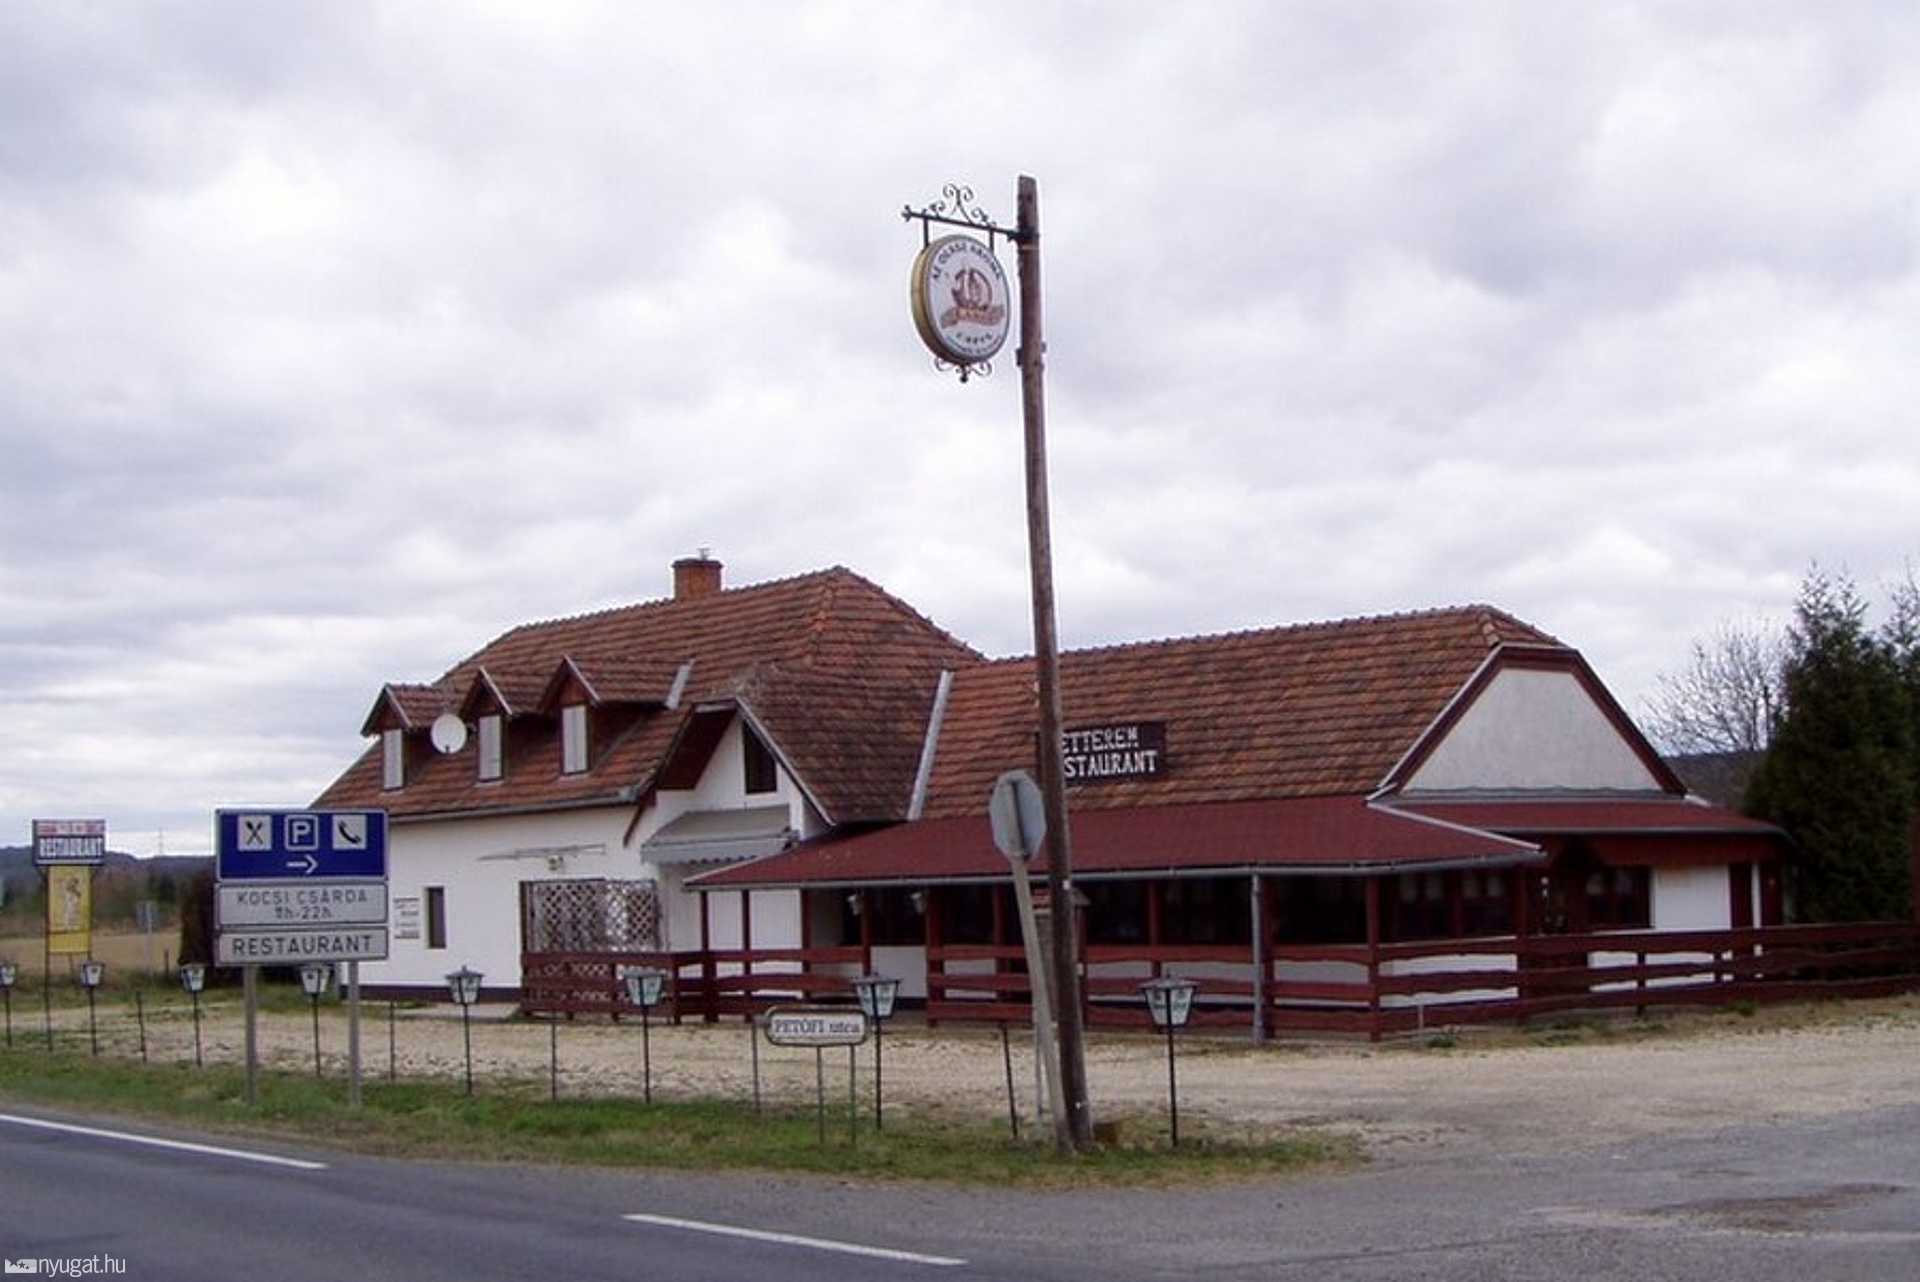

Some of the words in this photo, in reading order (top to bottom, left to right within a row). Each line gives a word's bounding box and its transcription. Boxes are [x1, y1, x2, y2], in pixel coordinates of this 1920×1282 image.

[1063, 750, 1158, 777] STAURANT
[292, 821, 311, 844] P
[237, 890, 289, 905] KOCSI
[232, 934, 372, 956] RESTAURANT
